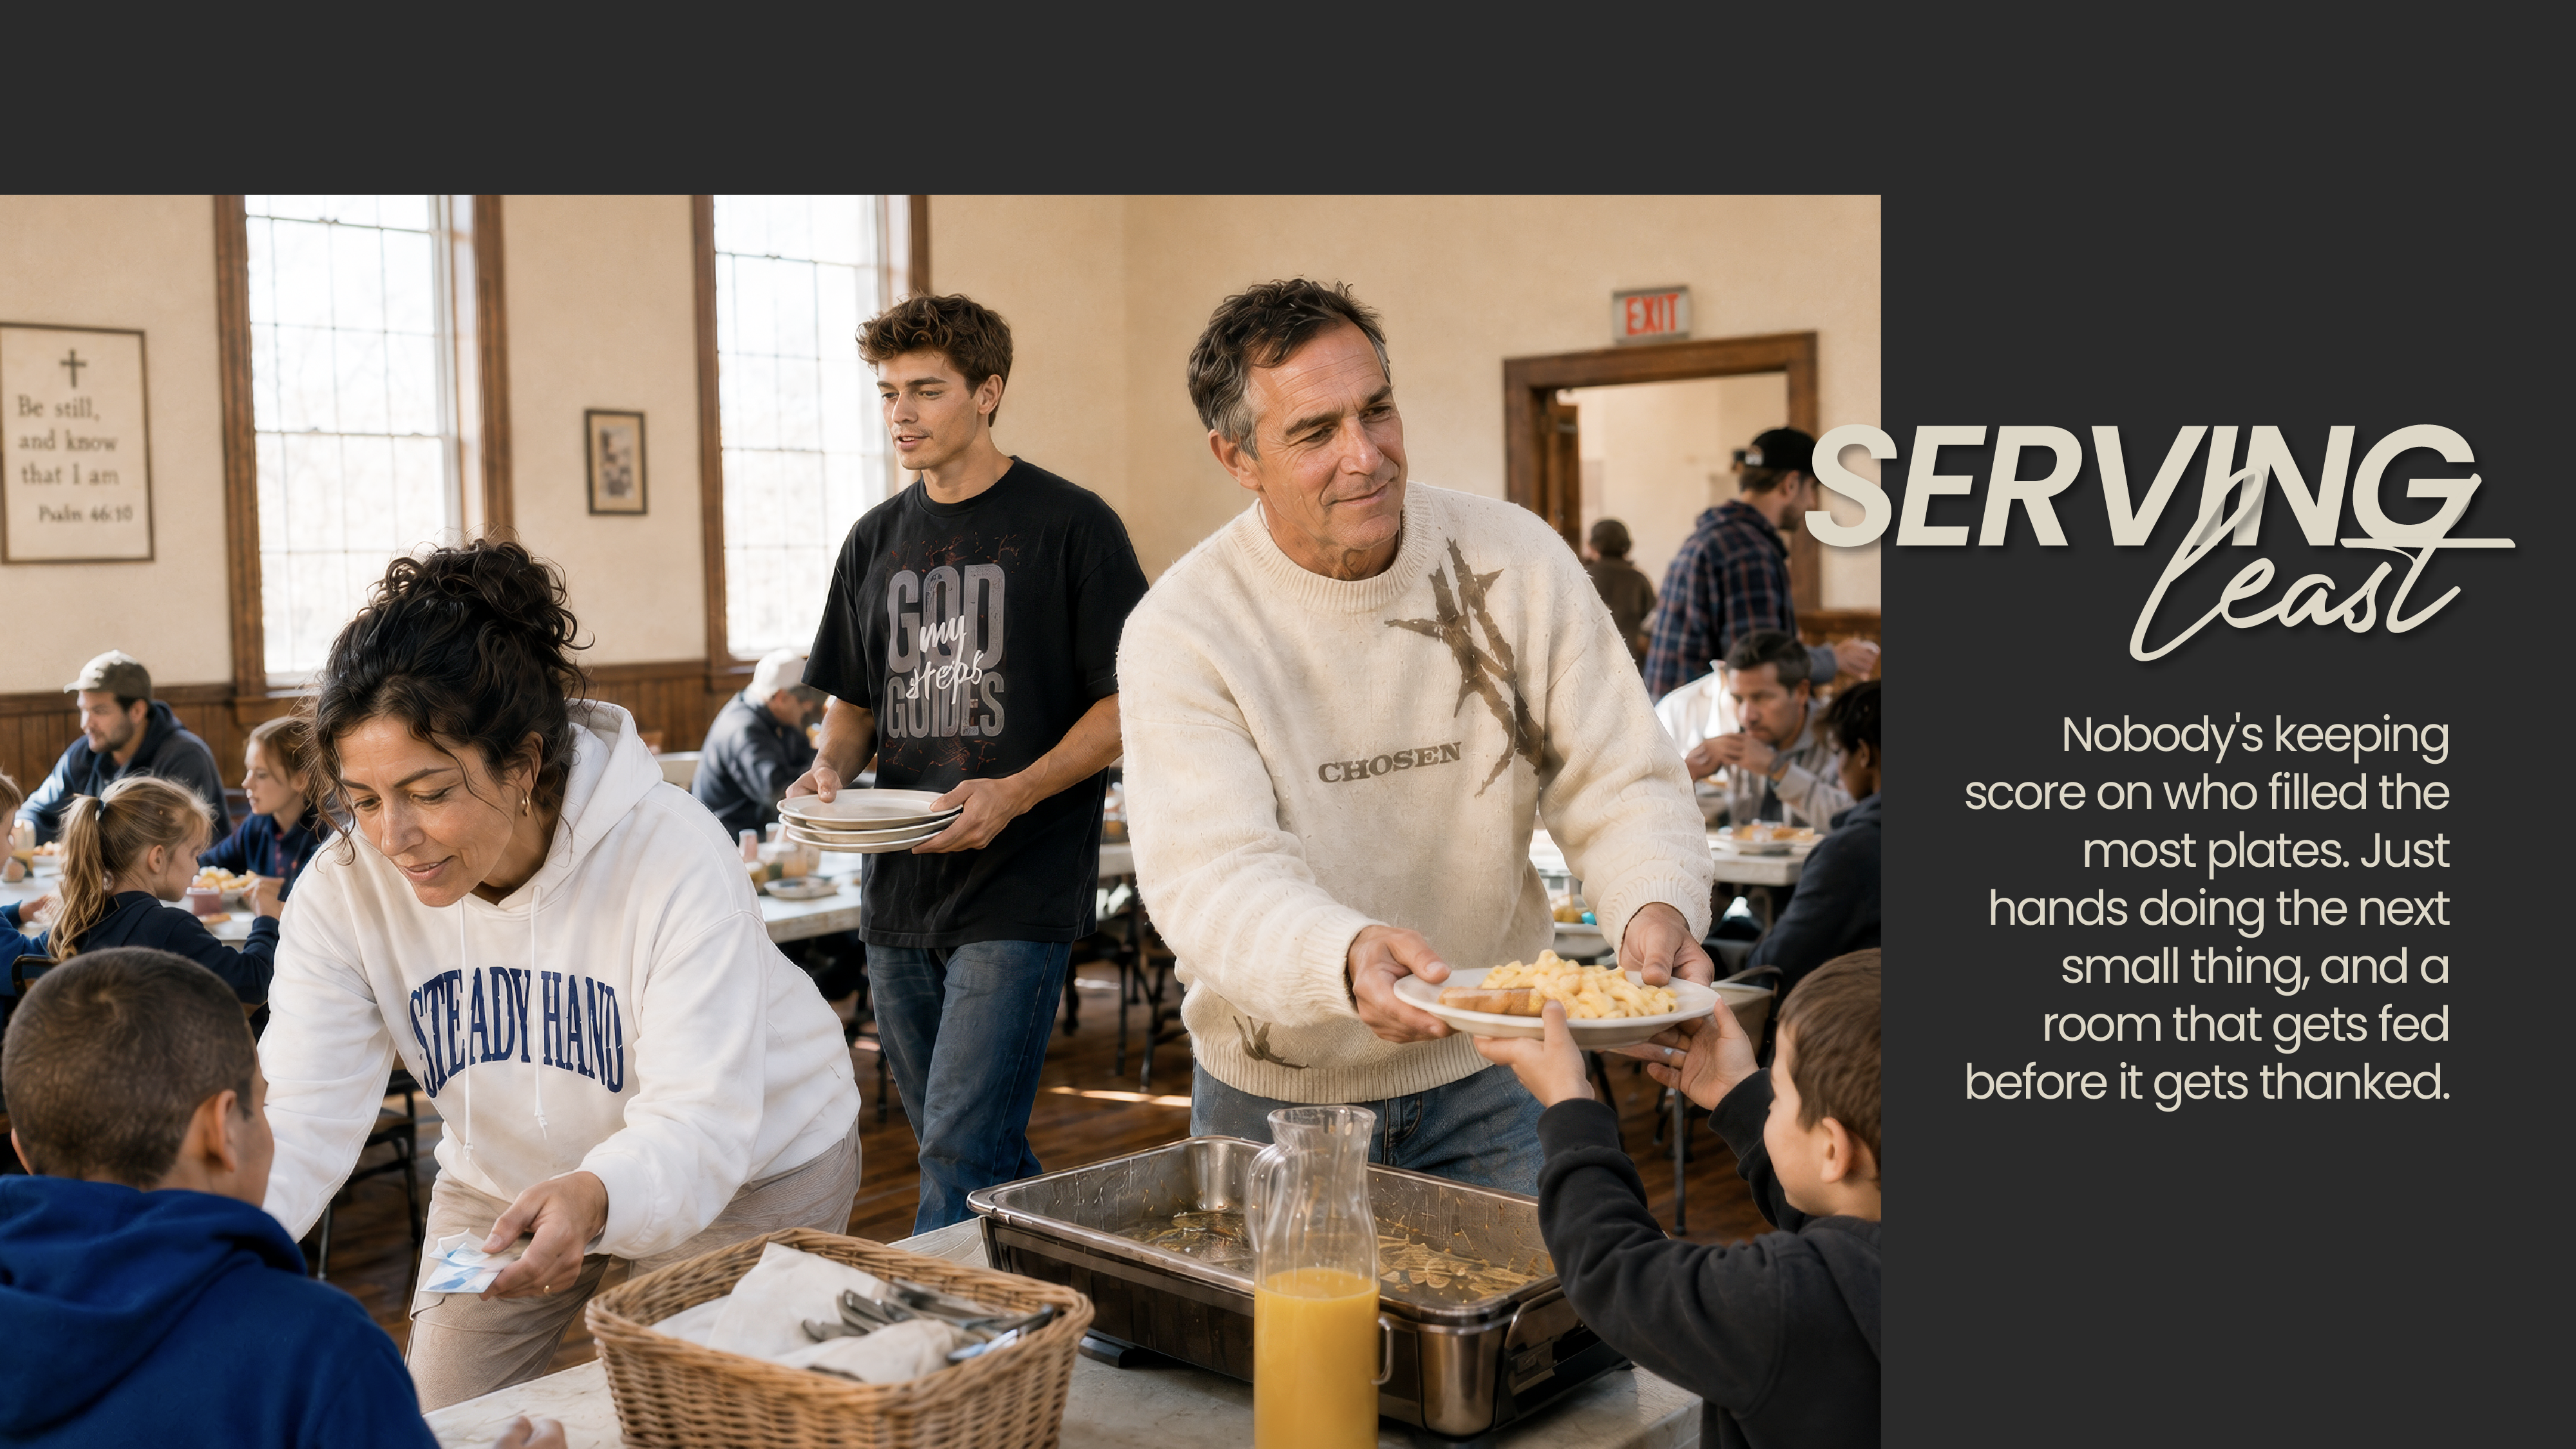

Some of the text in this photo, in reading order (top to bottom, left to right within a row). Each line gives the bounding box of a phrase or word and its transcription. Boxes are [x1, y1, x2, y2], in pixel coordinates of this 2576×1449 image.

[1625, 293, 1679, 336] EXIT
[18, 394, 100, 422] Be still,
[18, 428, 118, 451] and know
[21, 462, 120, 486] that I am
[887, 564, 1005, 673] GOD
[919, 614, 967, 667] my
[905, 650, 984, 705] steps
[887, 671, 1005, 739] GUIDES
[1318, 741, 1462, 783] CHOSEN
[409, 966, 624, 1099] STEADY HAND
